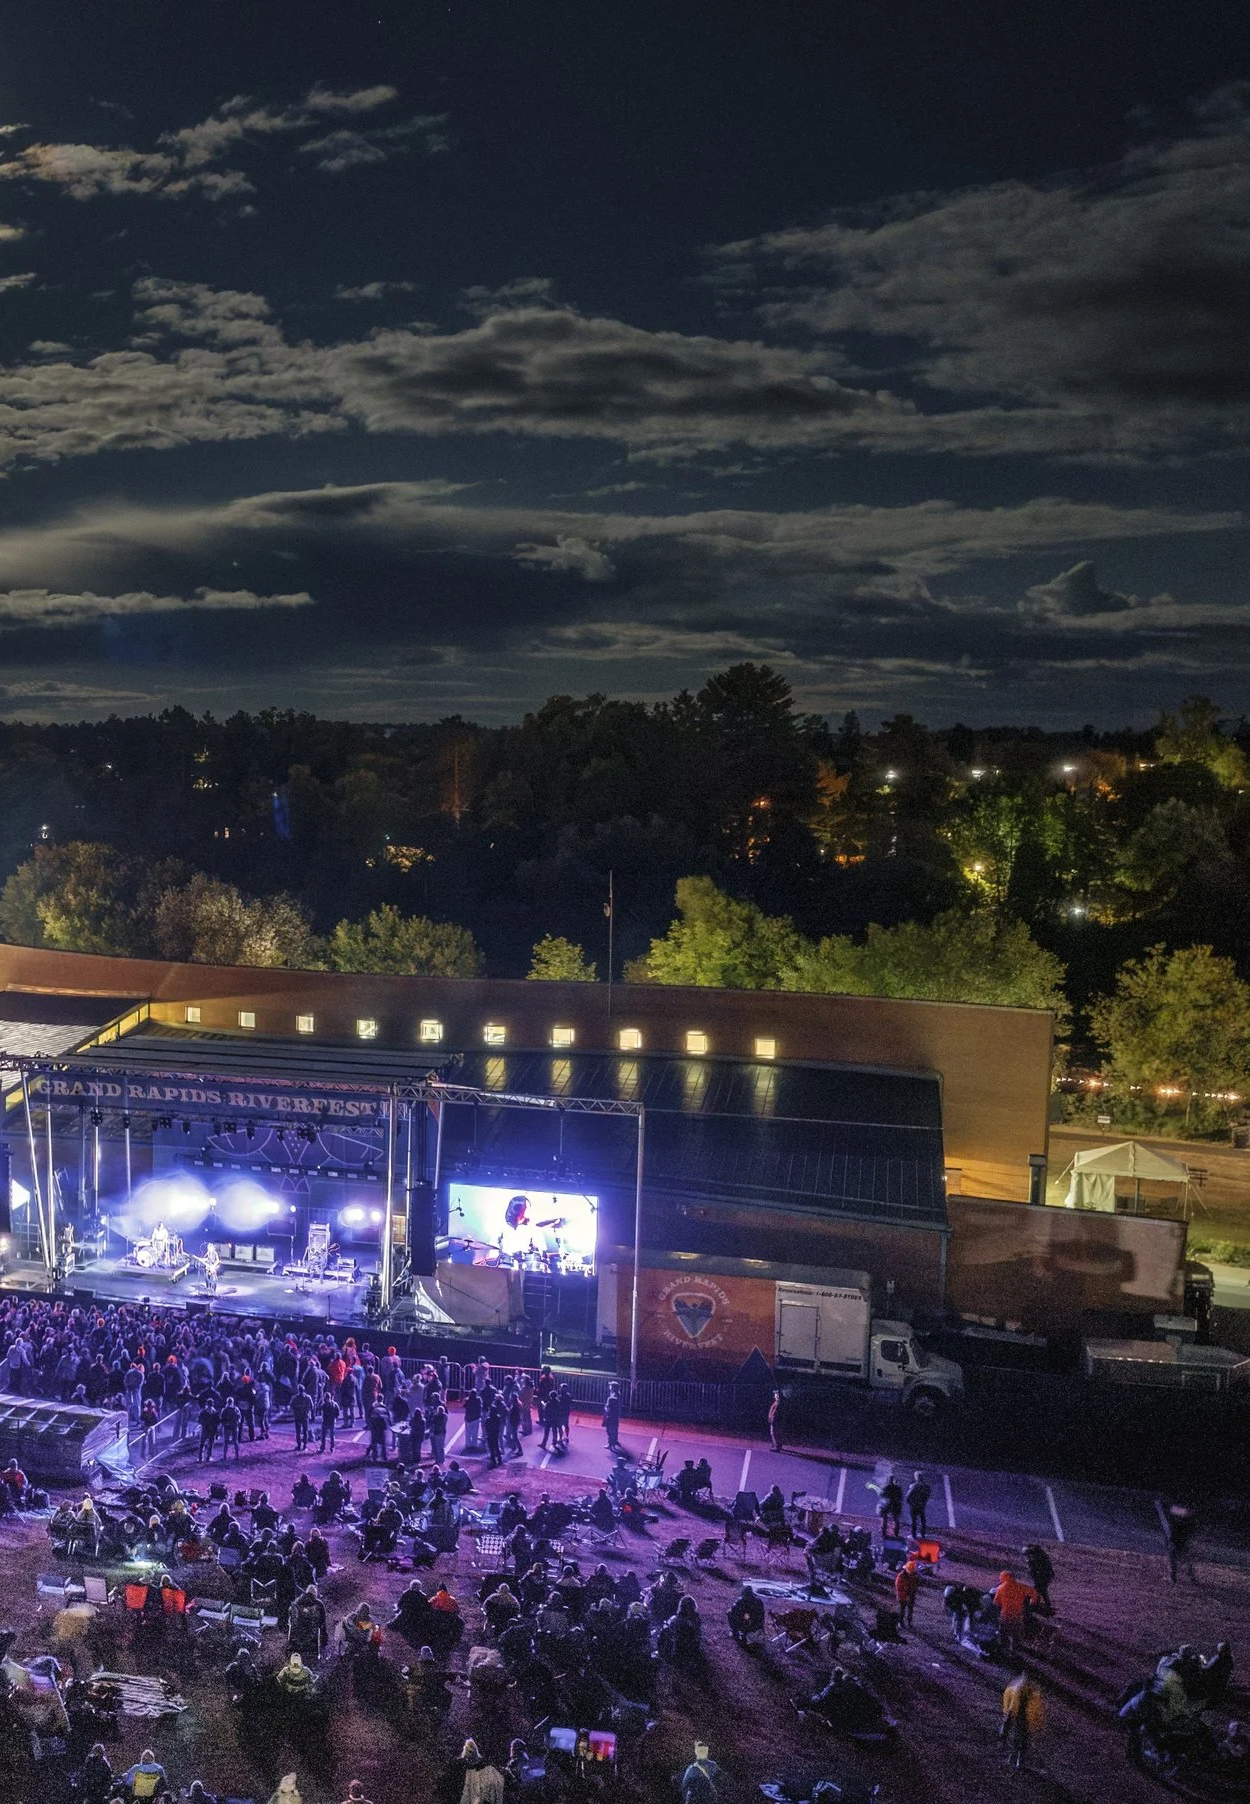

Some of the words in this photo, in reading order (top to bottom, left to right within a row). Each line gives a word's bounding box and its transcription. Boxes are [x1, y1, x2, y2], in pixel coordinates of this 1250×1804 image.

[36, 1080, 122, 1097] GRAND
[127, 1084, 222, 1105] RAPIDS
[228, 1092, 377, 1117] RIVERFEST
[658, 1276, 691, 1301] GRAND
[694, 1276, 730, 1305] RAPIDS
